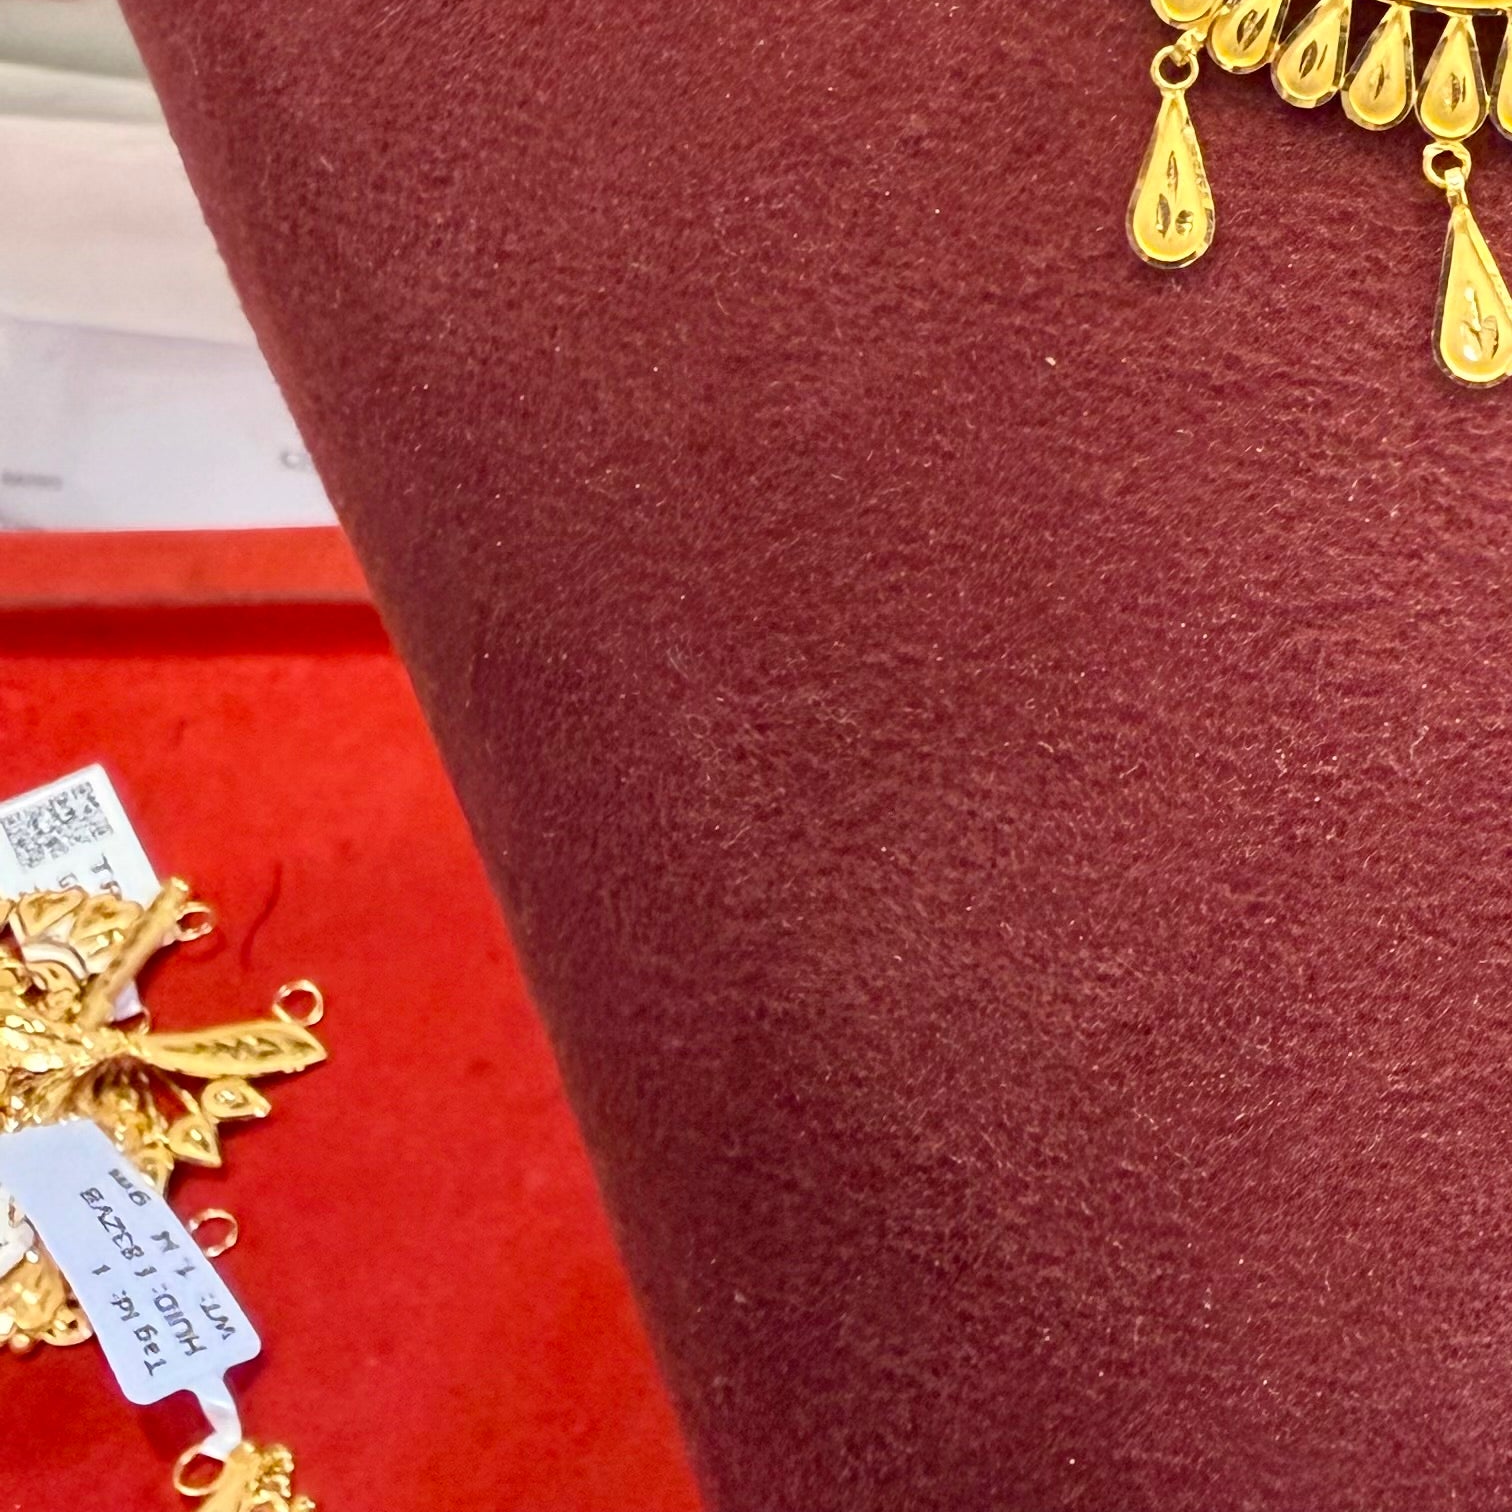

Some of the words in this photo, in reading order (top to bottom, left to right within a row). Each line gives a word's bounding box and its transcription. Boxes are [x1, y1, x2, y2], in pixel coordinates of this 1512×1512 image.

[152, 1284, 207, 1356] HUID:
[200, 1292, 236, 1340] WT:
[134, 1324, 167, 1376] Tag
